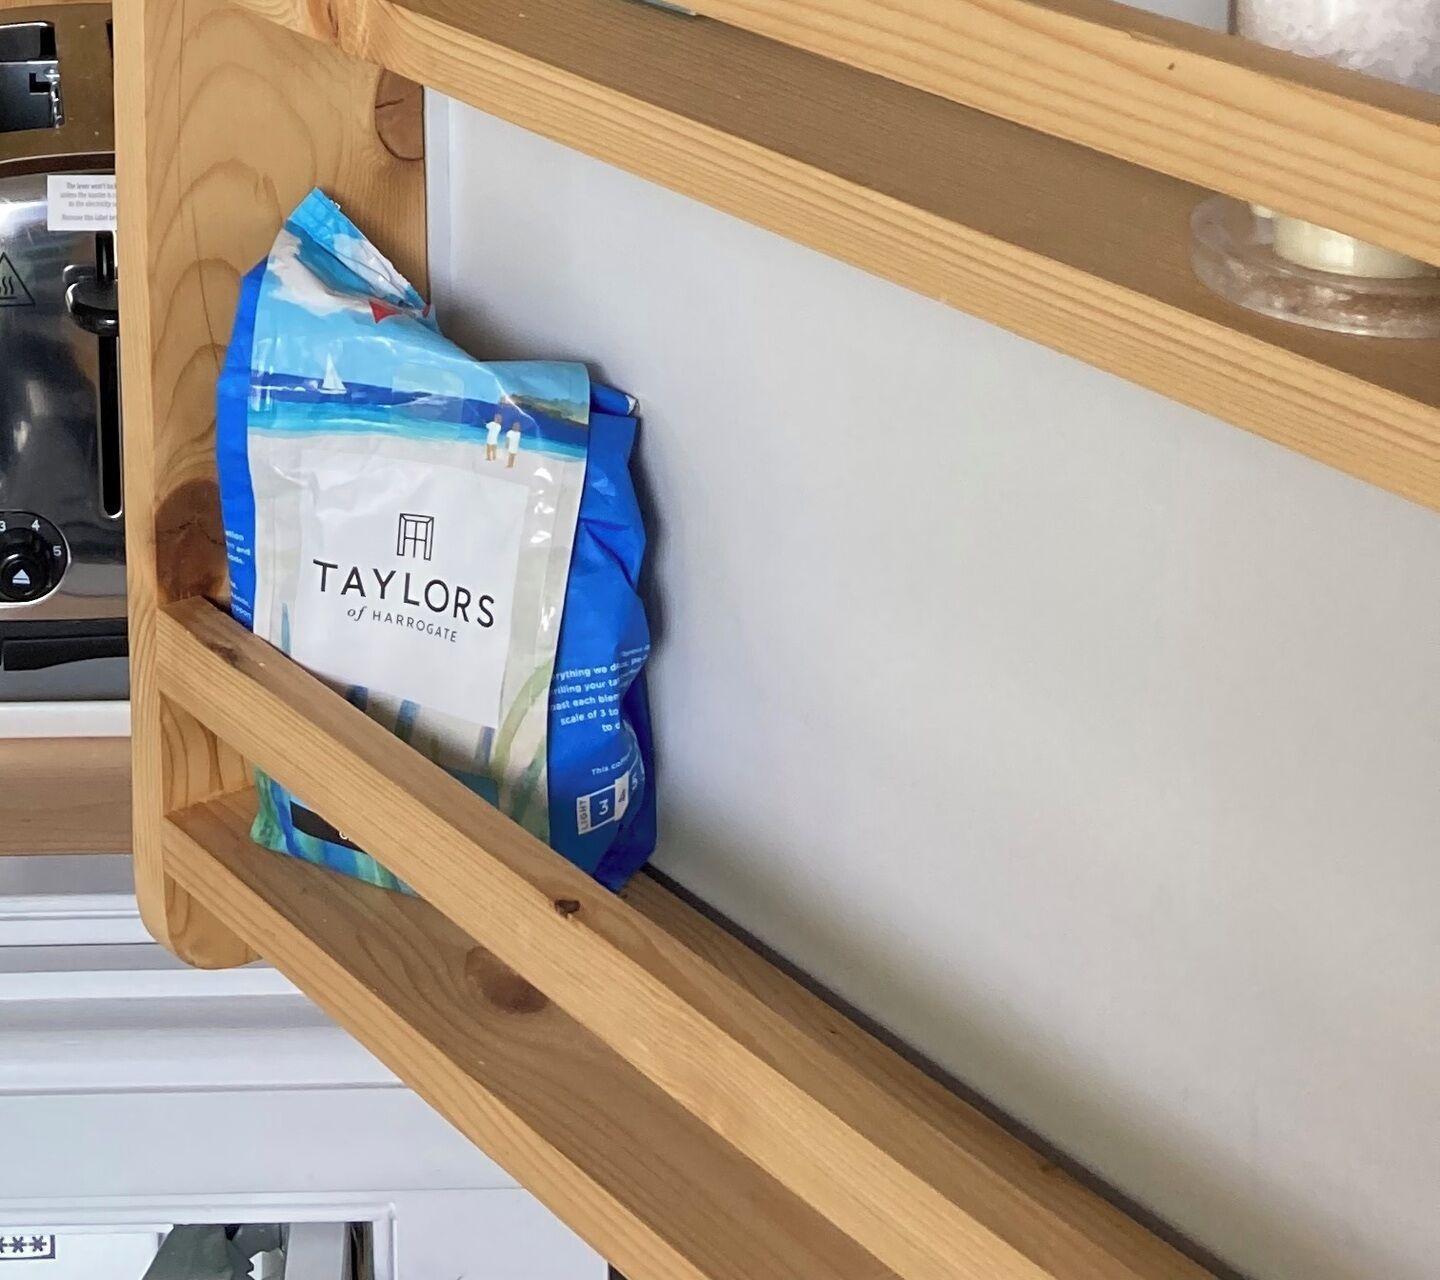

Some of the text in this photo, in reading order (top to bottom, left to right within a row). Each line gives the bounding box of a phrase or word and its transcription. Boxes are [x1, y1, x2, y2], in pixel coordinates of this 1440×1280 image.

[31, 519, 40, 531] 4
[52, 545, 62, 556] 5
[313, 559, 495, 628] TAYLORS
[347, 606, 458, 643] of HARROGATE
[584, 680, 606, 692] your
[573, 695, 596, 706] each
[560, 708, 619, 726] scale of 3 to
[601, 723, 613, 732] to
[599, 798, 609, 816] 3
